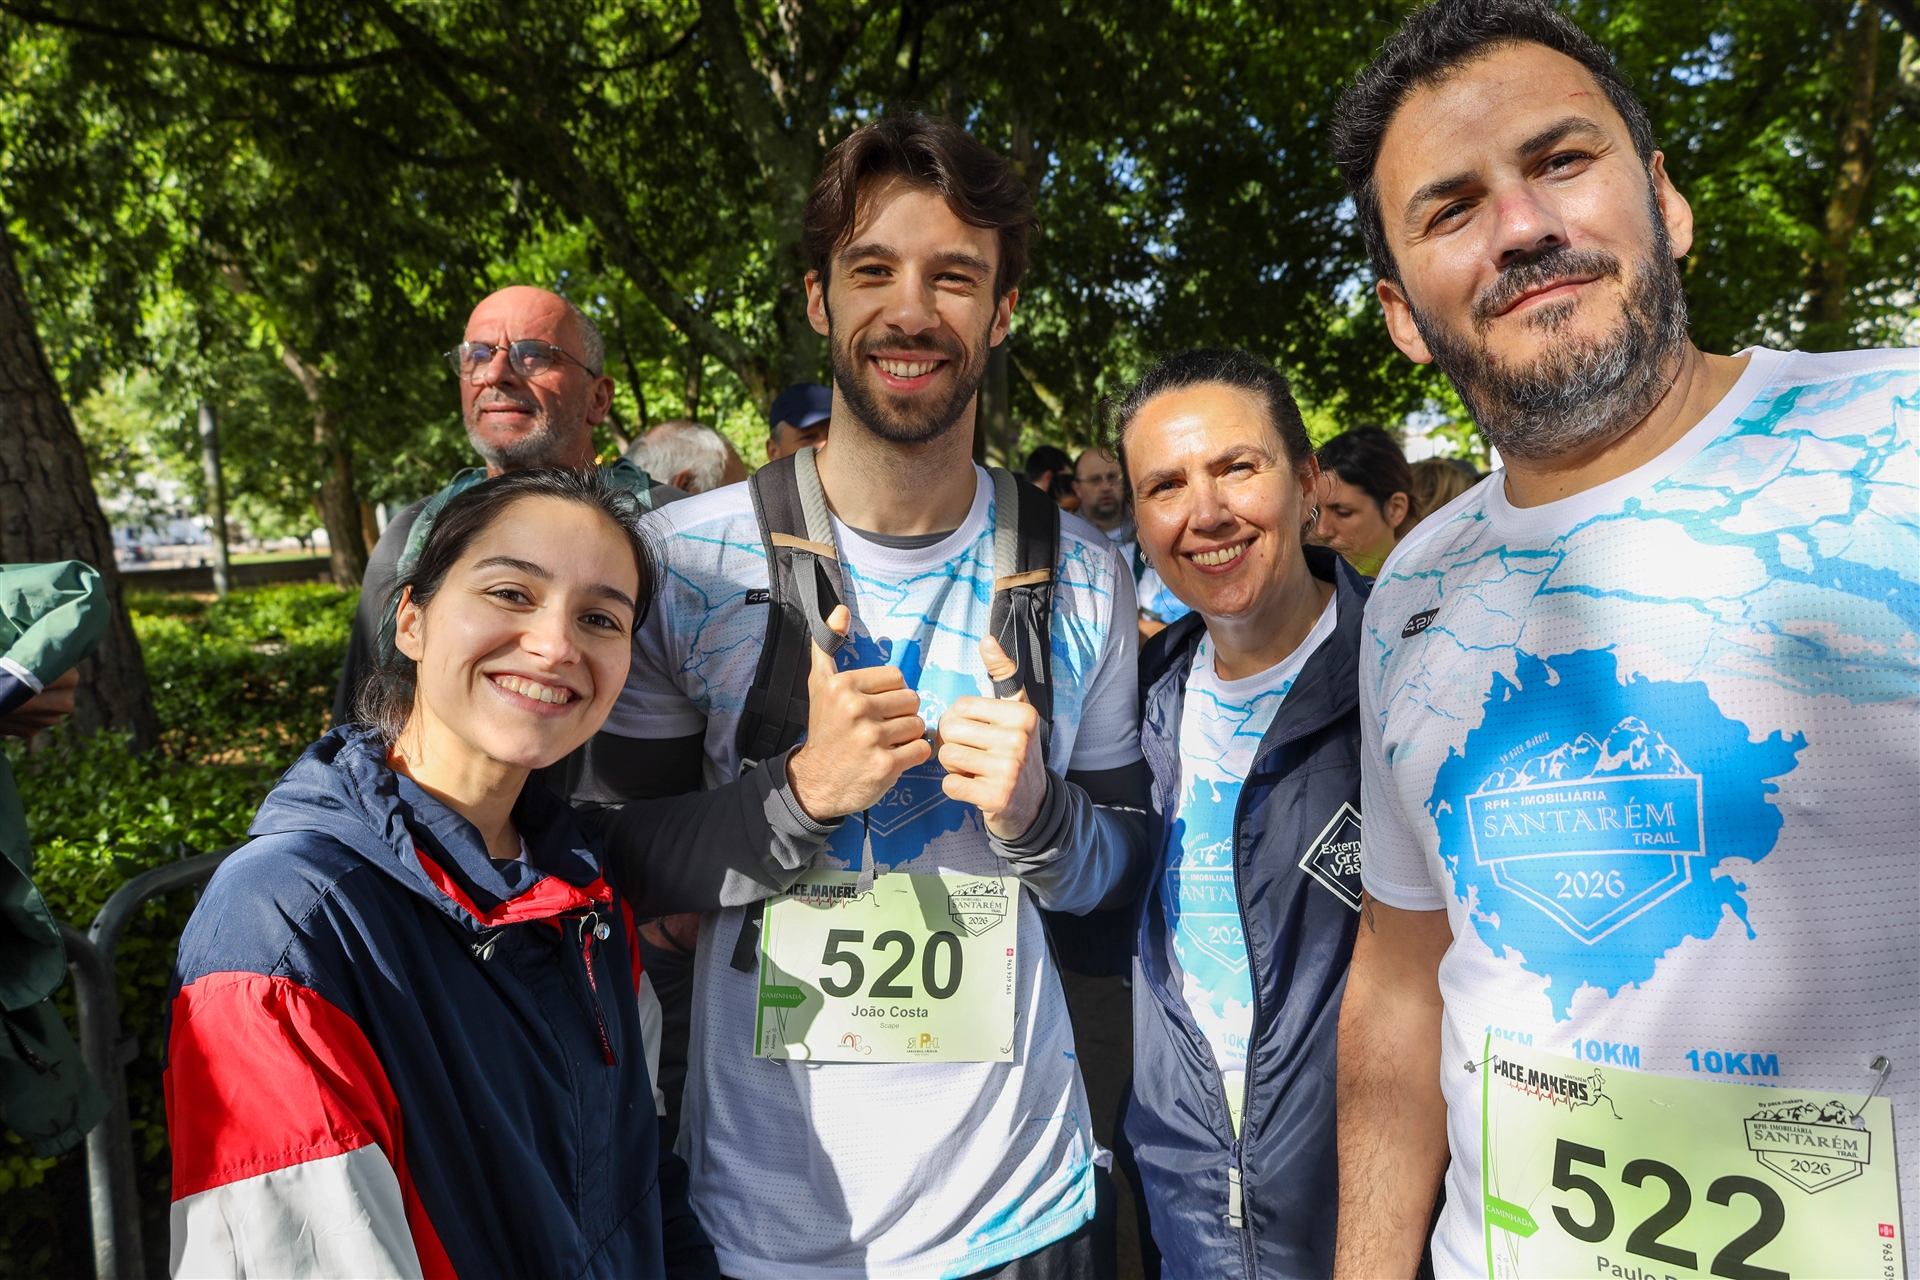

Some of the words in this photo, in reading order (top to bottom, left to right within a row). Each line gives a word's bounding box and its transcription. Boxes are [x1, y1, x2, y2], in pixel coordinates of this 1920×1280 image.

[749, 592, 769, 602] 42
[922, 764, 948, 774] TRAIL
[876, 787, 913, 807] 26
[1484, 798, 1510, 811] RPH
[1520, 789, 1607, 804] IMOBILIÁRIA
[1484, 797, 1677, 838] SANTARÉM
[1322, 840, 1361, 854] Extern
[1632, 831, 1680, 846] TRAIL
[1190, 873, 1233, 882] IMOBILIÁRI
[1330, 863, 1361, 877] Vas
[785, 883, 858, 899] ACE.MAKERS
[1173, 884, 1236, 902] SANTA
[1554, 869, 1626, 899] 2026
[952, 900, 1002, 909] SANTARÉM
[968, 916, 988, 925] 2026
[1208, 925, 1244, 945] 202
[818, 929, 963, 1000] 520
[761, 992, 802, 1000] CAMINHADA
[851, 1005, 885, 1017] João
[889, 1005, 929, 1018] Costa
[879, 1022, 900, 1030] Scape
[1221, 1032, 1250, 1051] 10K
[1572, 1038, 1640, 1069] 10KM
[1685, 1050, 1780, 1077] 10KM
[1494, 1056, 1588, 1101] PACE.MAKERS
[1754, 1129, 1859, 1151] SANTARÉM
[1836, 1150, 1860, 1158] TRAIL
[1790, 1158, 1832, 1176] 2026
[1485, 1204, 1534, 1229] CAMINHADA
[1551, 1137, 1790, 1280] 522
[1882, 1243, 1894, 1262] 963
[1884, 1265, 1895, 1280] 93
